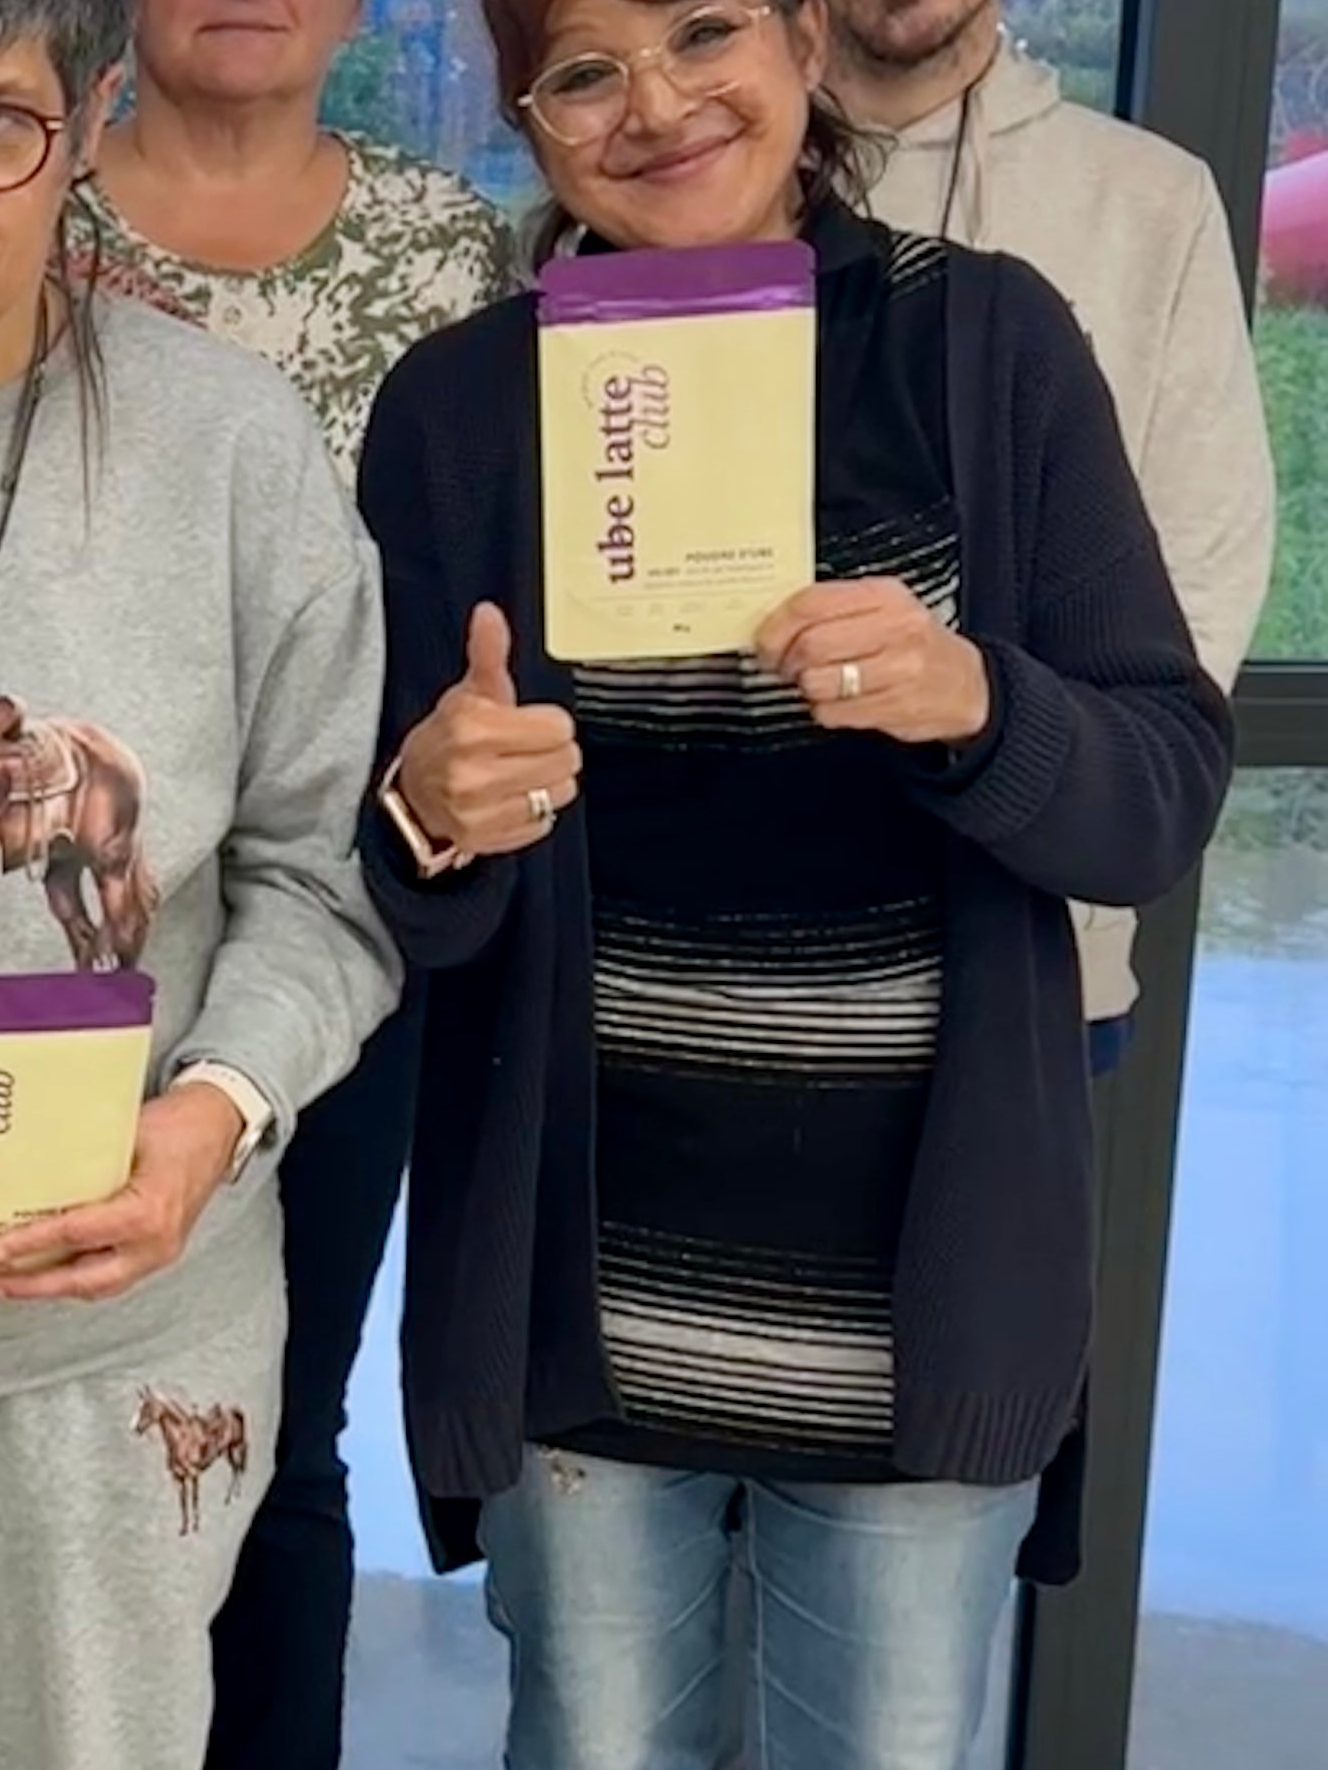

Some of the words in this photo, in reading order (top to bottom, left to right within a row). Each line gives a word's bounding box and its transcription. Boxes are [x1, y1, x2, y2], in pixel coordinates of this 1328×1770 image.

[594, 375, 636, 482] latte
[630, 363, 670, 451] club
[596, 494, 635, 583] ube
